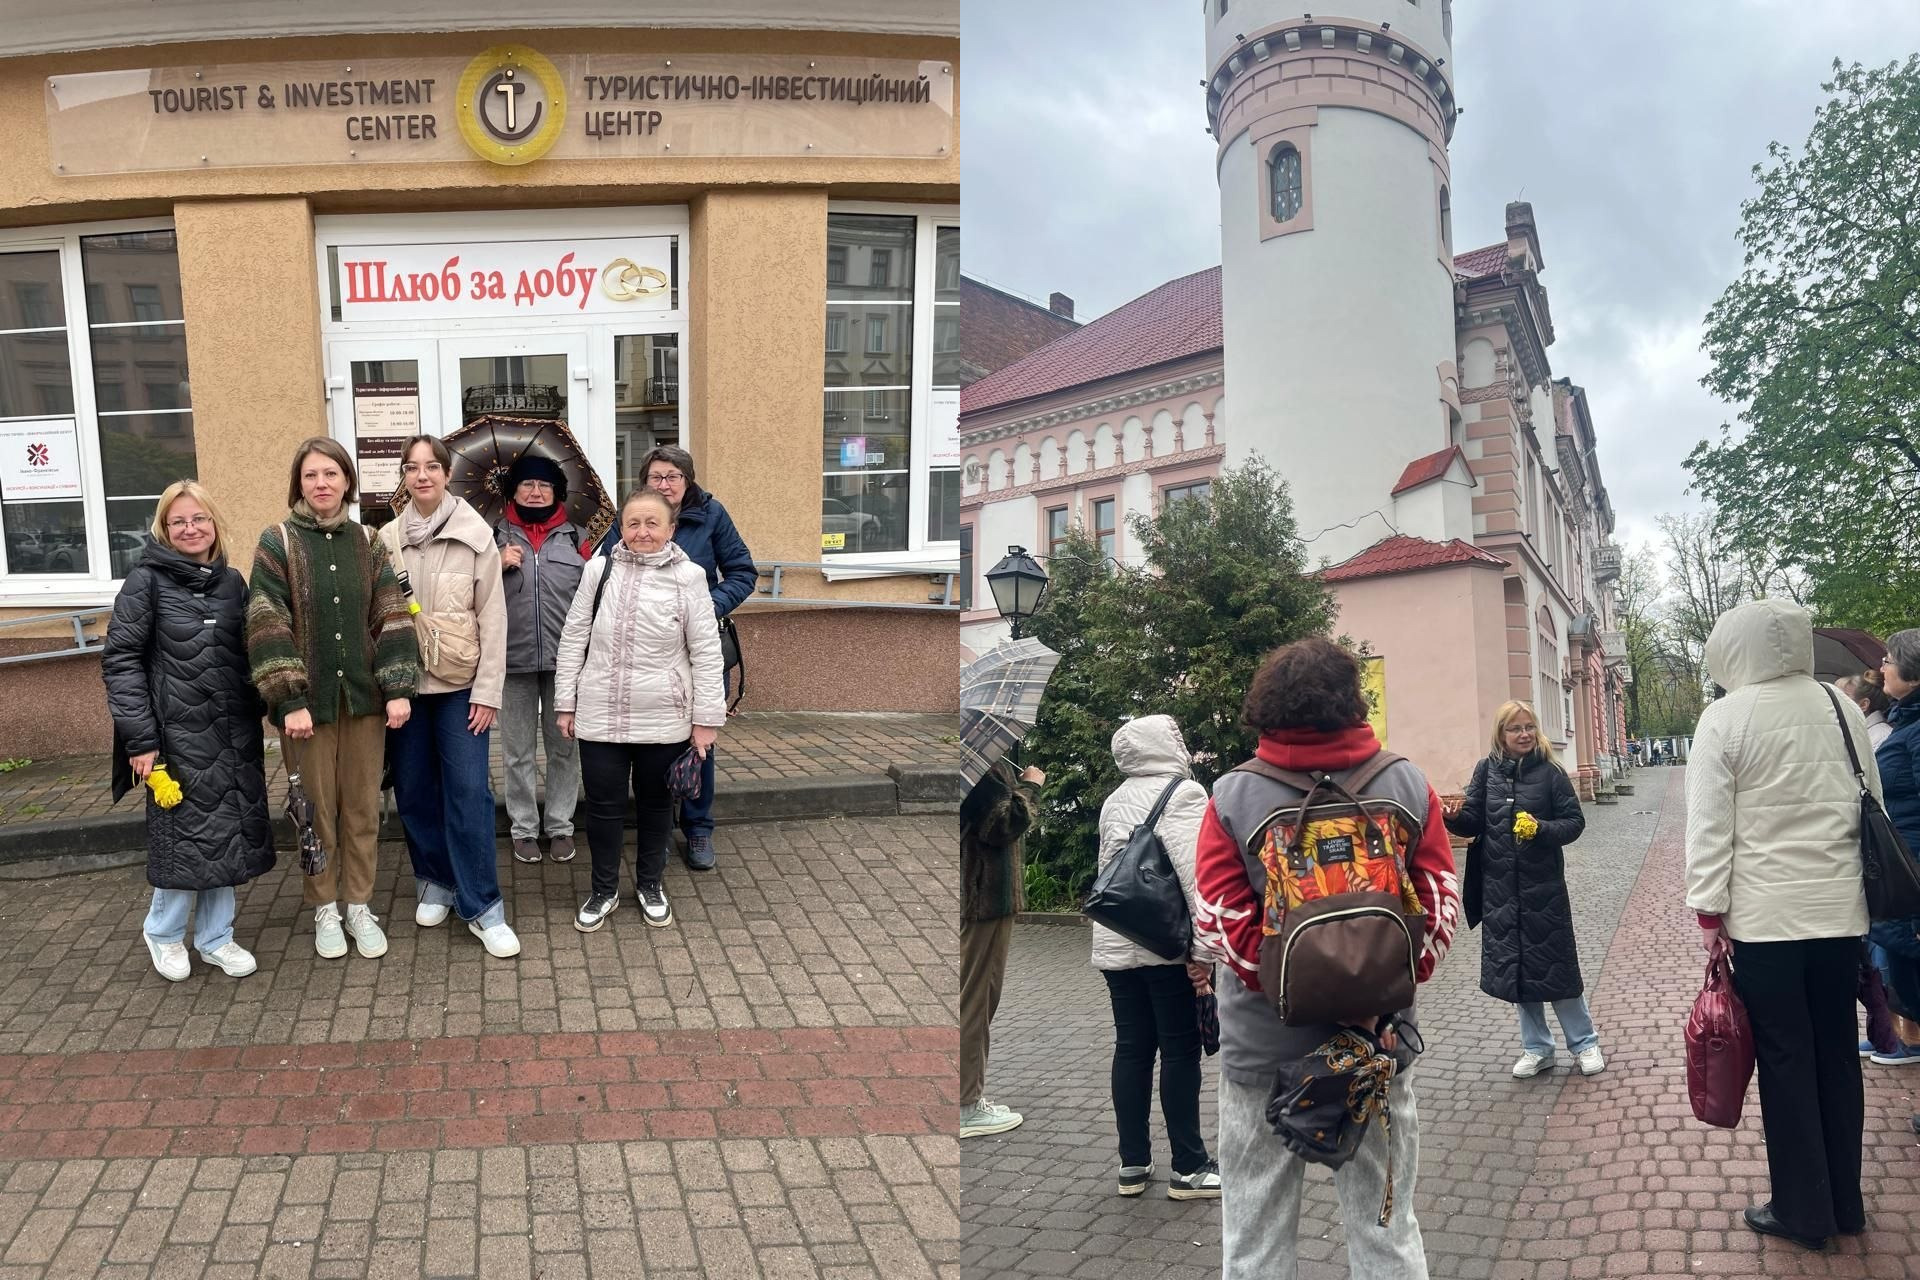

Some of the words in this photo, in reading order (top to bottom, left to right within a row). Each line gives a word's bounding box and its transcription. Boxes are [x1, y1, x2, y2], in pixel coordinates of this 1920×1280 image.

[149, 85, 247, 114] TOURIST
[257, 84, 276, 109] &
[285, 79, 435, 108] INVESTMENT
[584, 73, 931, 105] ТУРИСТИЧНО-ІНВЕСТИЦІЙНИЙ
[346, 114, 437, 141] CENTER
[585, 111, 663, 140] ЦЕНТР
[344, 256, 461, 304] Шлюб
[470, 271, 506, 300] за
[514, 251, 597, 310] добу
